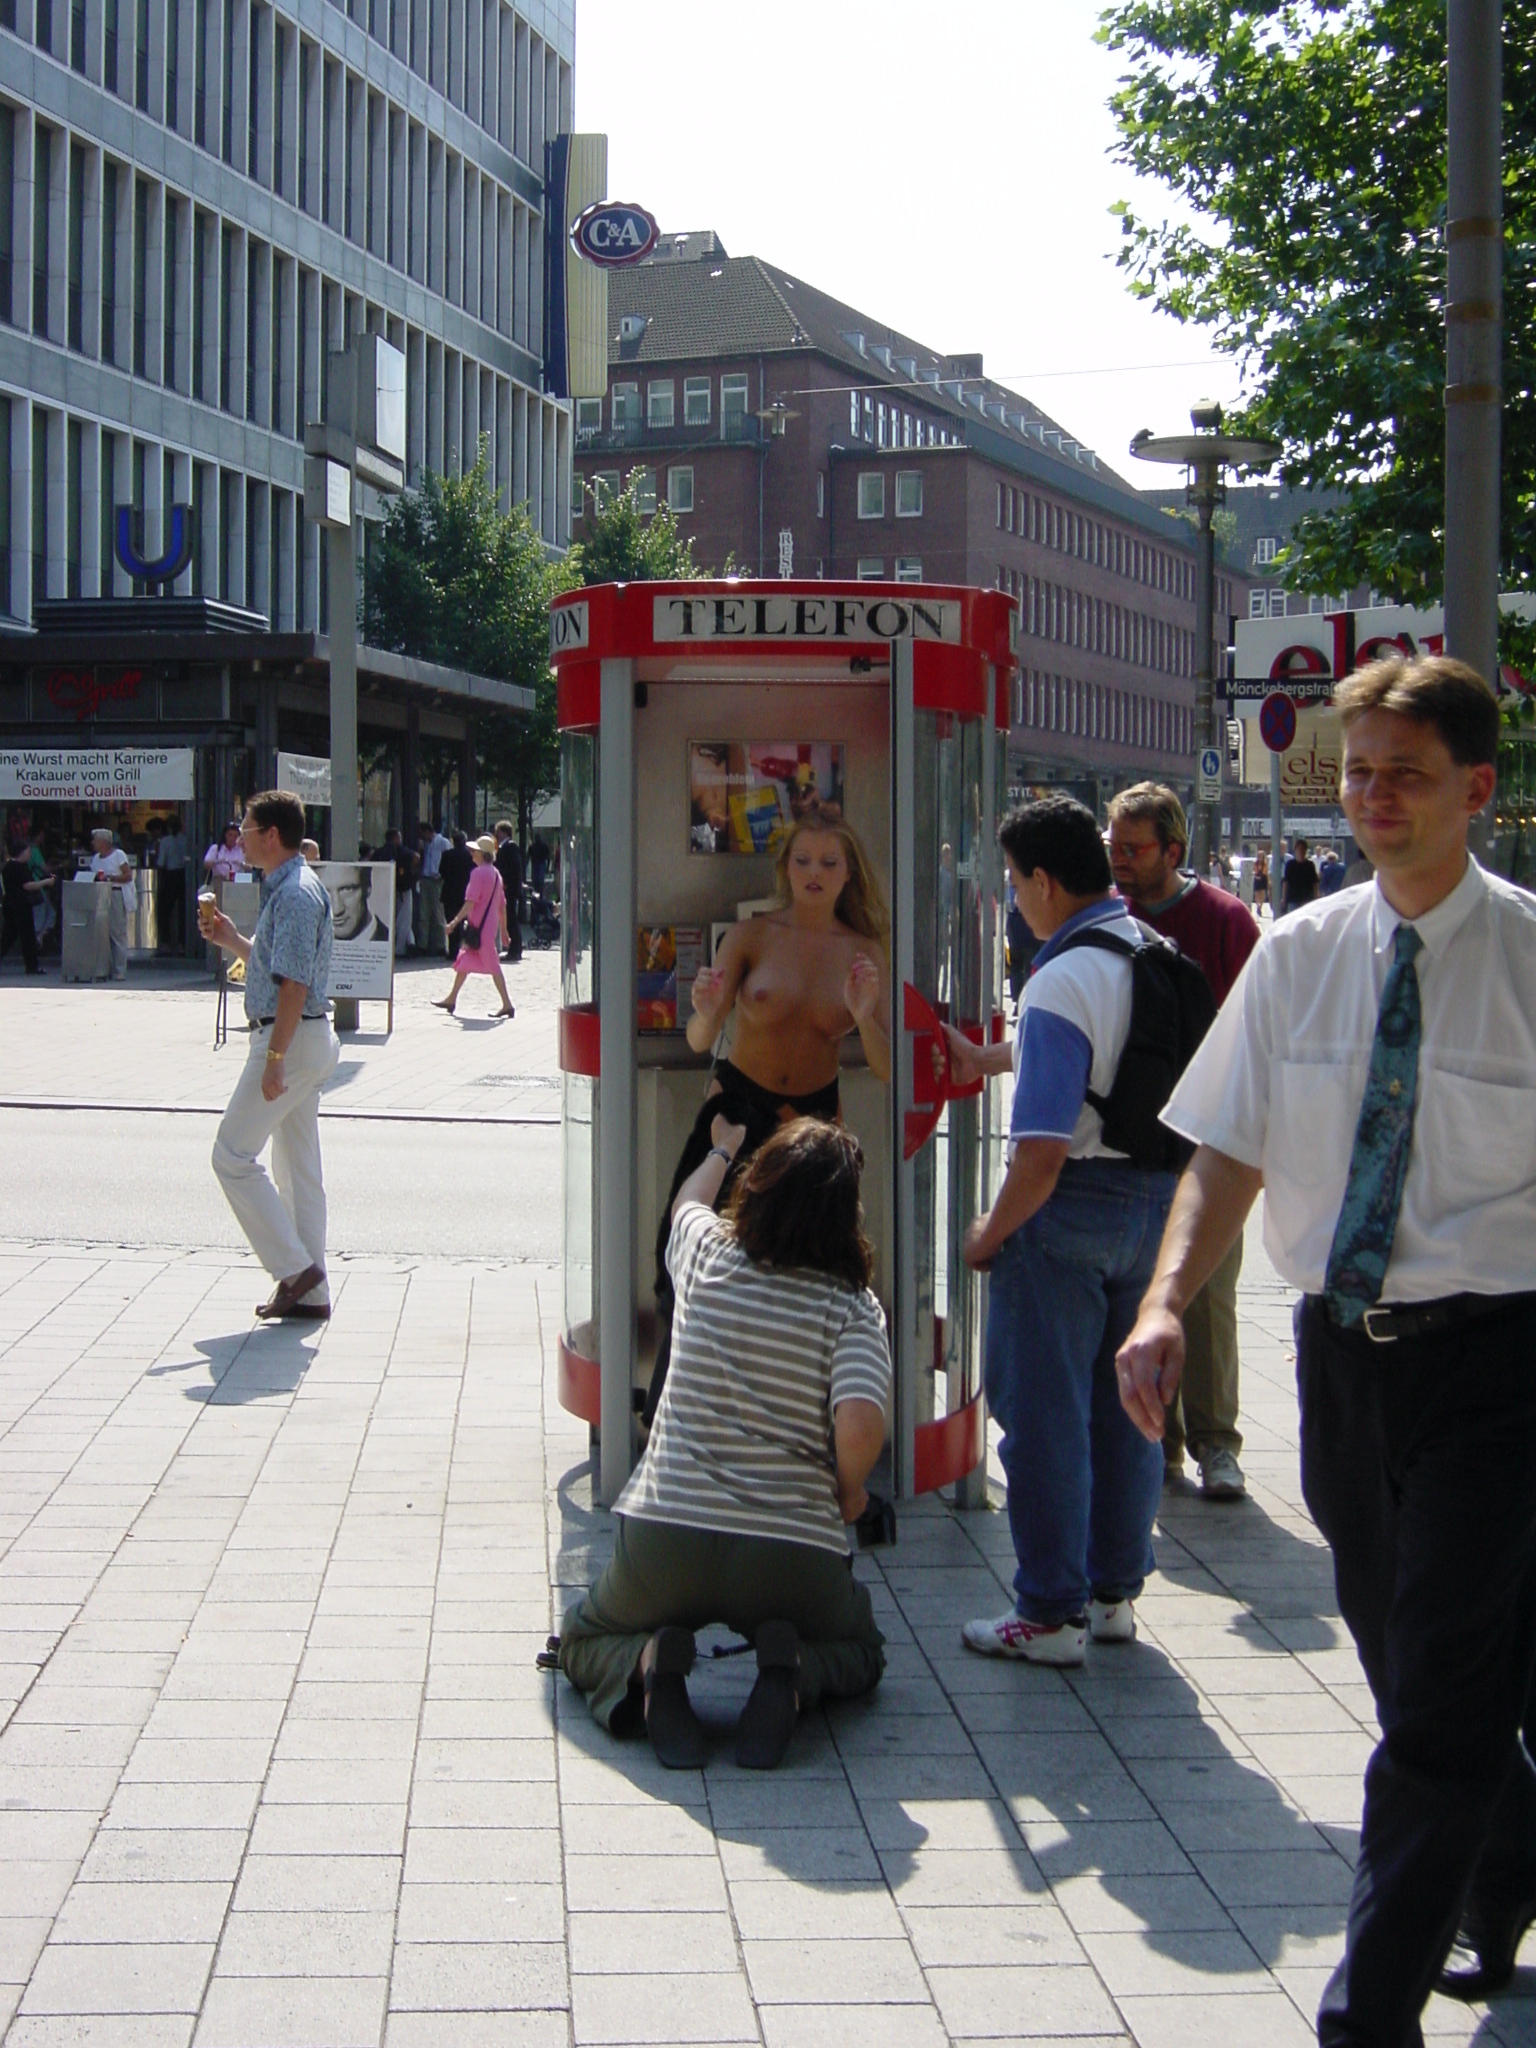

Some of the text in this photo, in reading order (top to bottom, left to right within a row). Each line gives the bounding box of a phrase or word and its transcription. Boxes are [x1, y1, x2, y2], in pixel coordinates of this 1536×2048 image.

[589, 218, 642, 247] C&A
[552, 607, 582, 646] ON
[669, 600, 946, 638] TELEFON
[23, 752, 63, 765] Wurst
[67, 752, 110, 765] macht
[114, 752, 168, 765] Karriere
[16, 768, 141, 781] Krakauer vom Grill
[21, 784, 137, 797] Gourmet Qualität
